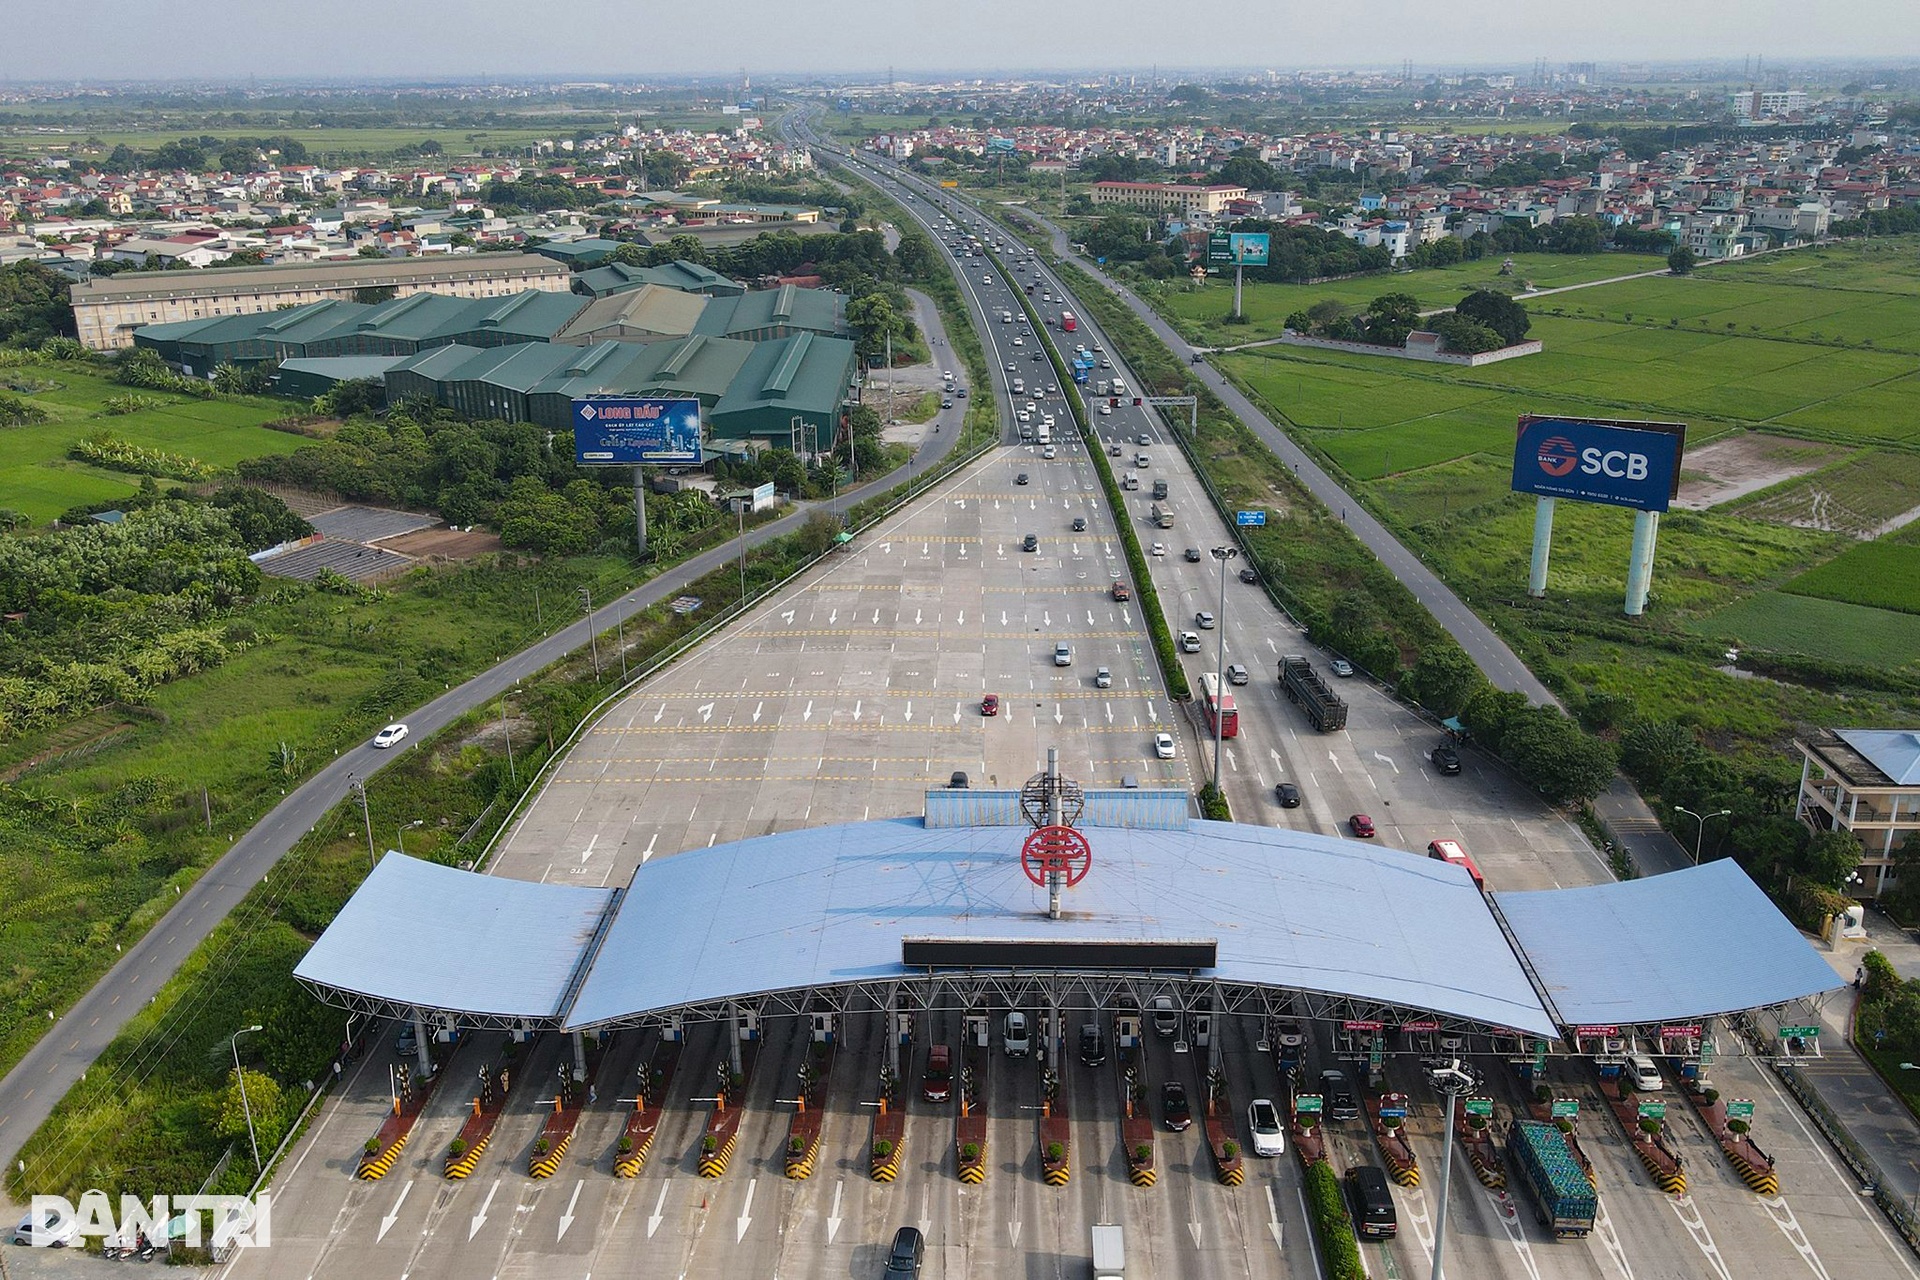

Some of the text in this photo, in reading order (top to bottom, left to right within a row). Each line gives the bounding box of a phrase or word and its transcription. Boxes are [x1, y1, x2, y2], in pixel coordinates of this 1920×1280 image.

[598, 406, 631, 419] LONG
[1538, 455, 1557, 463] BANK
[1580, 447, 1648, 481] SCB
